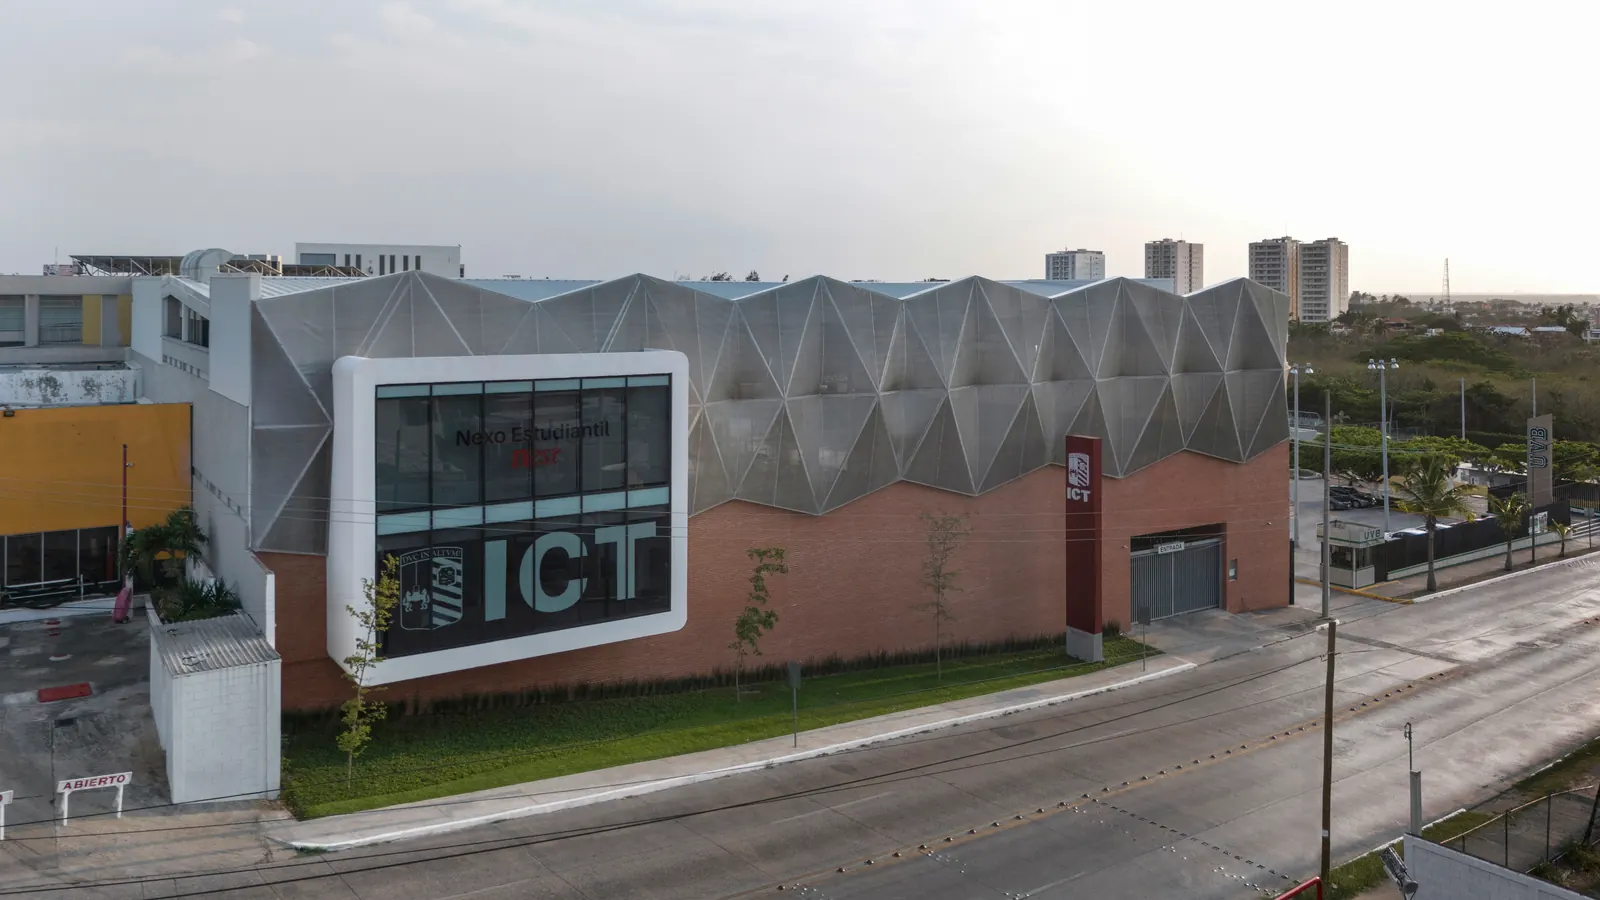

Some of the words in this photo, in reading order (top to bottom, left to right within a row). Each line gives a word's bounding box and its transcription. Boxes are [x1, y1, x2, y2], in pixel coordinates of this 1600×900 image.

[456, 430, 506, 446] Nexo
[511, 421, 609, 442] Estudiantil
[512, 444, 561, 468] nest
[1530, 427, 1548, 468] UVB
[1066, 487, 1091, 502] ICT
[1364, 529, 1380, 540] UVB
[1160, 543, 1182, 553] ENTRADA
[484, 521, 657, 622] ICT
[63, 775, 126, 790] ABIERTO
